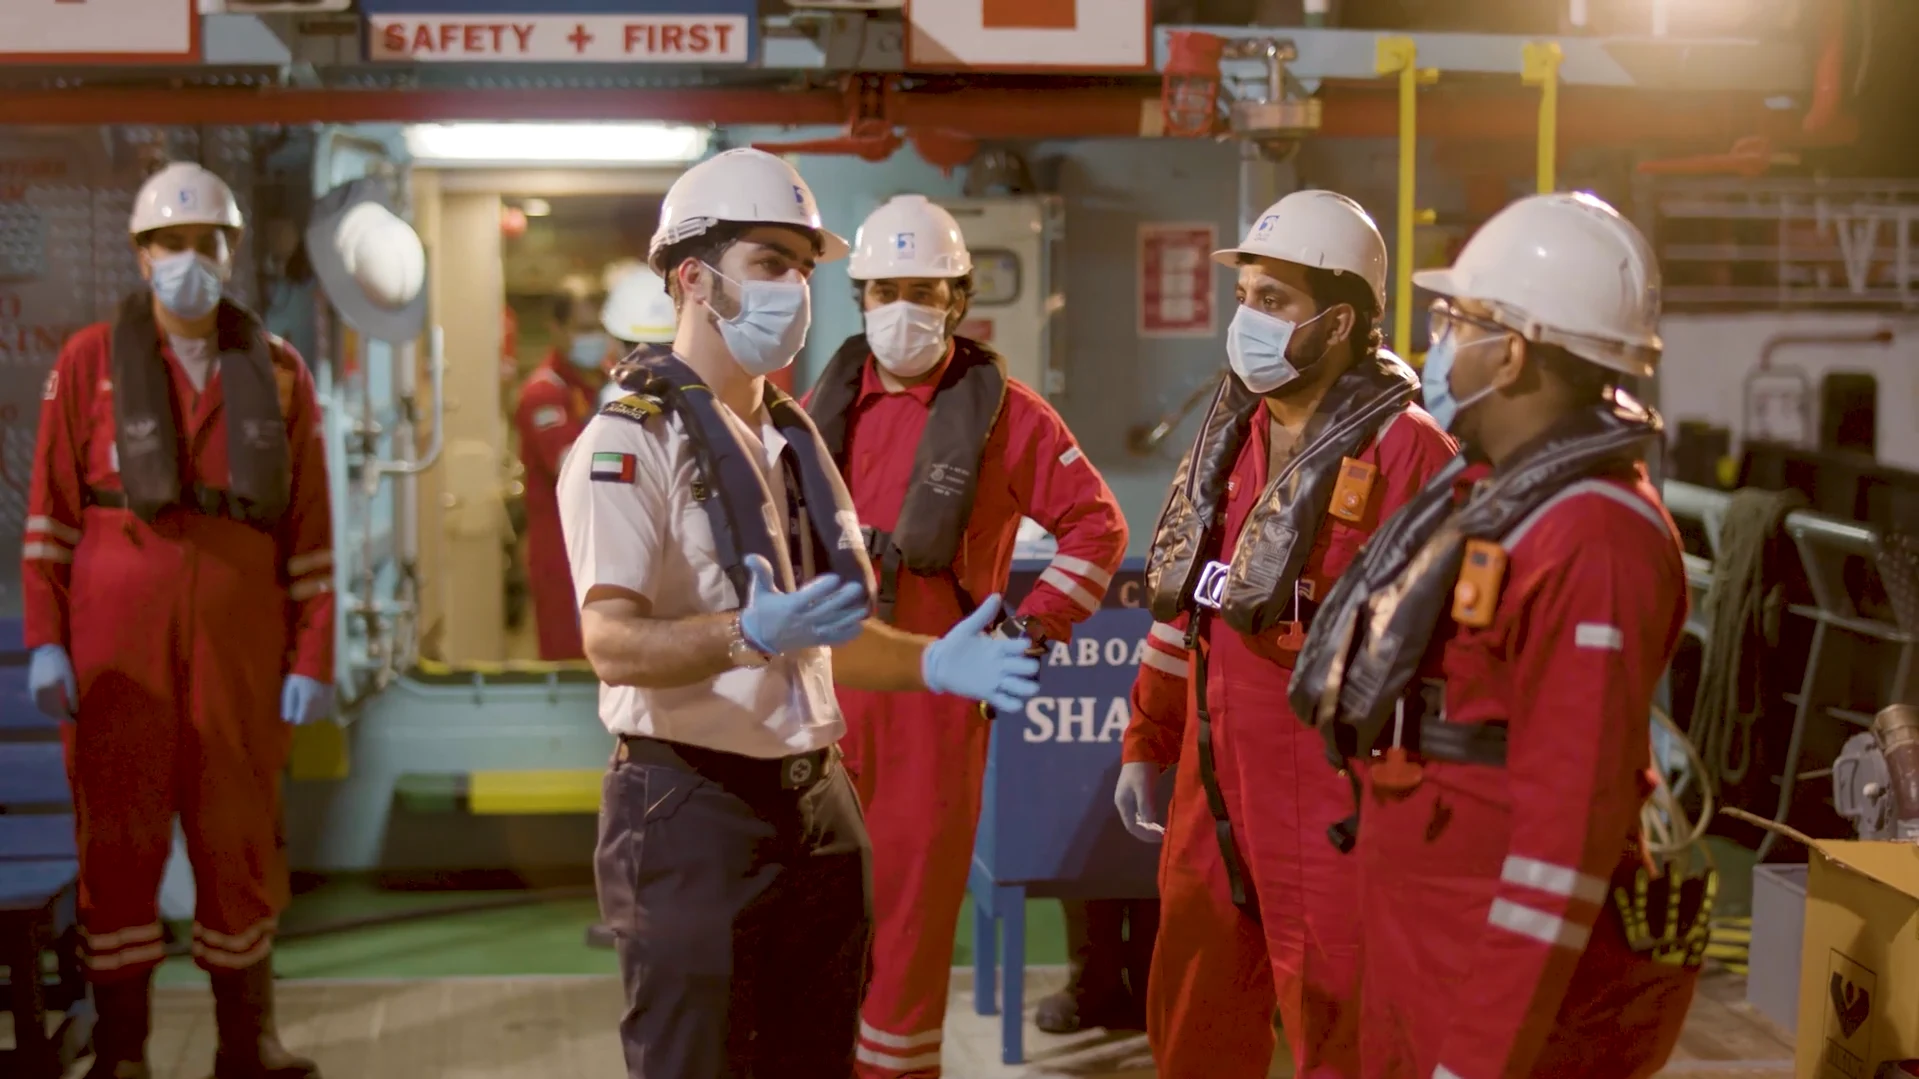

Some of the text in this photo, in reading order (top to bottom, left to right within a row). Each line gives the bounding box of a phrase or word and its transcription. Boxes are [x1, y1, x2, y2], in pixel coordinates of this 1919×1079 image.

[384, 23, 535, 53] SAFETY
[623, 23, 734, 53] FIRST
[1023, 696, 1131, 743] SHA
